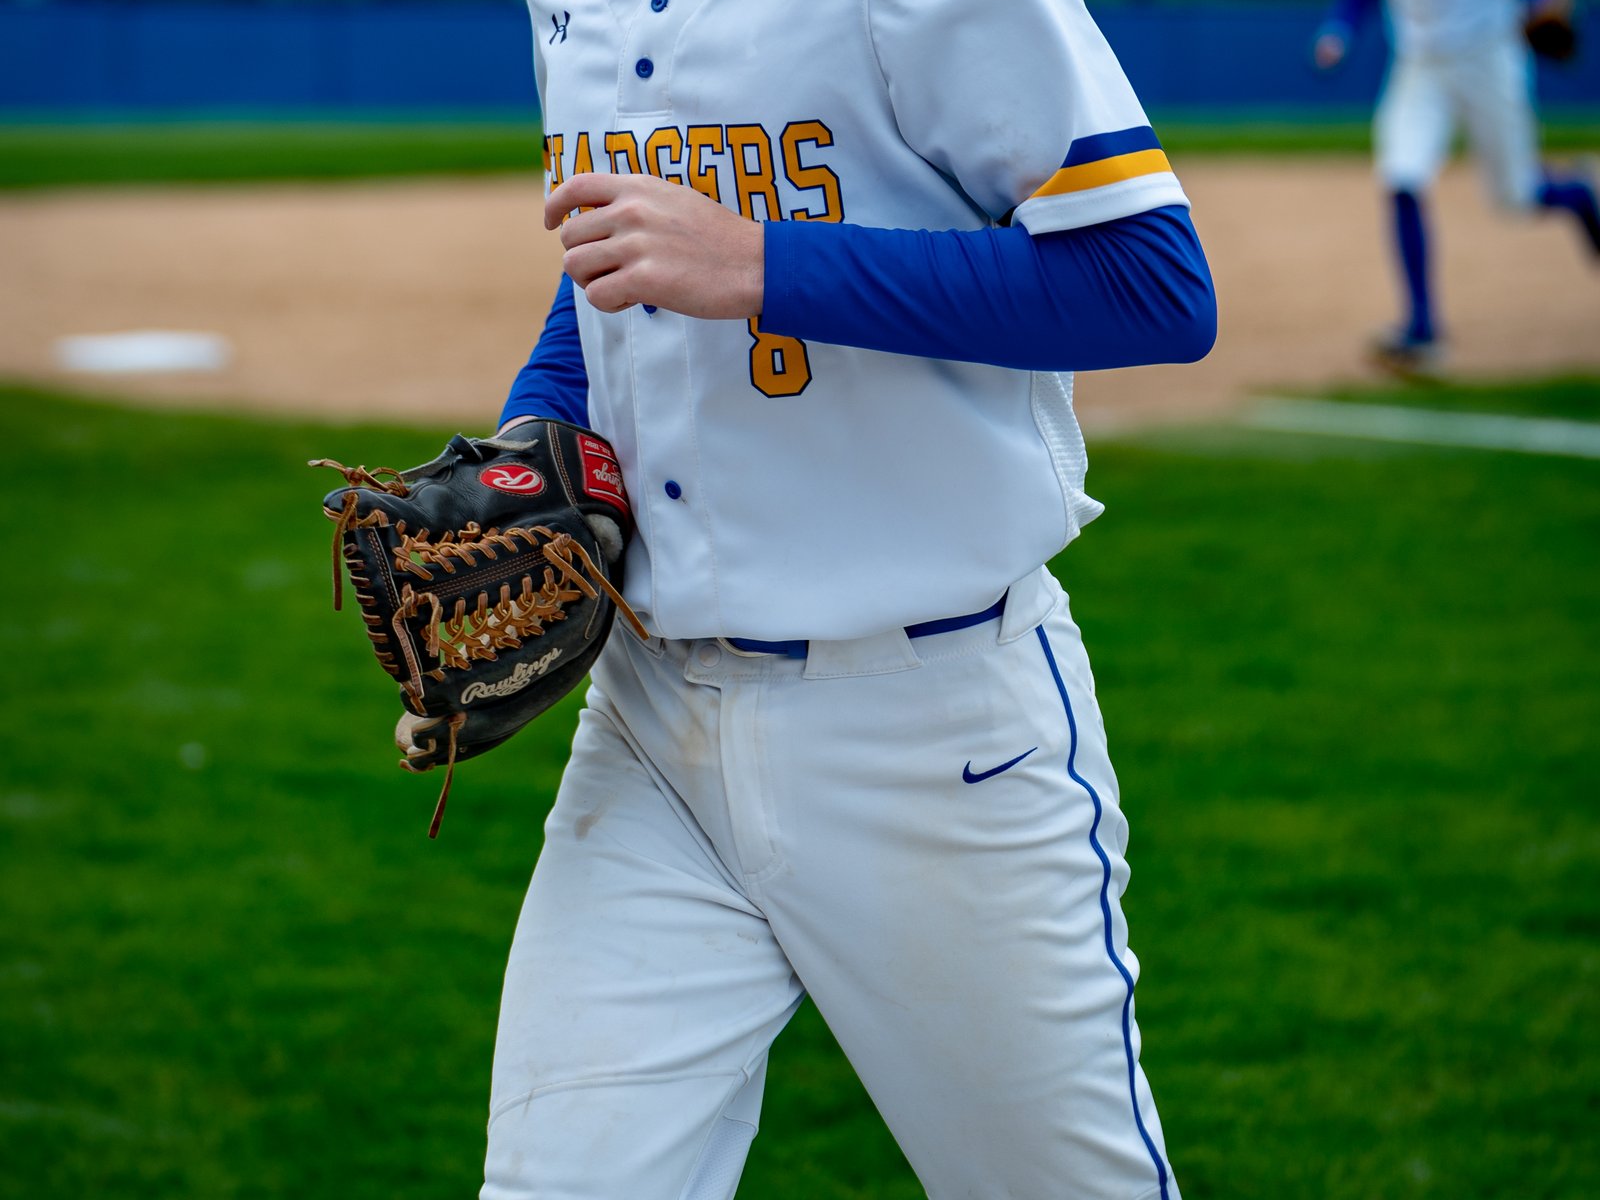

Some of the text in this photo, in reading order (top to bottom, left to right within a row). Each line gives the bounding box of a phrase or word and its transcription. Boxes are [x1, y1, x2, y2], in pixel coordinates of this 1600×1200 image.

[543, 118, 845, 226] HAGERS
[748, 314, 812, 398] 8
[592, 462, 623, 495] lings
[460, 647, 563, 705] Rawlings
